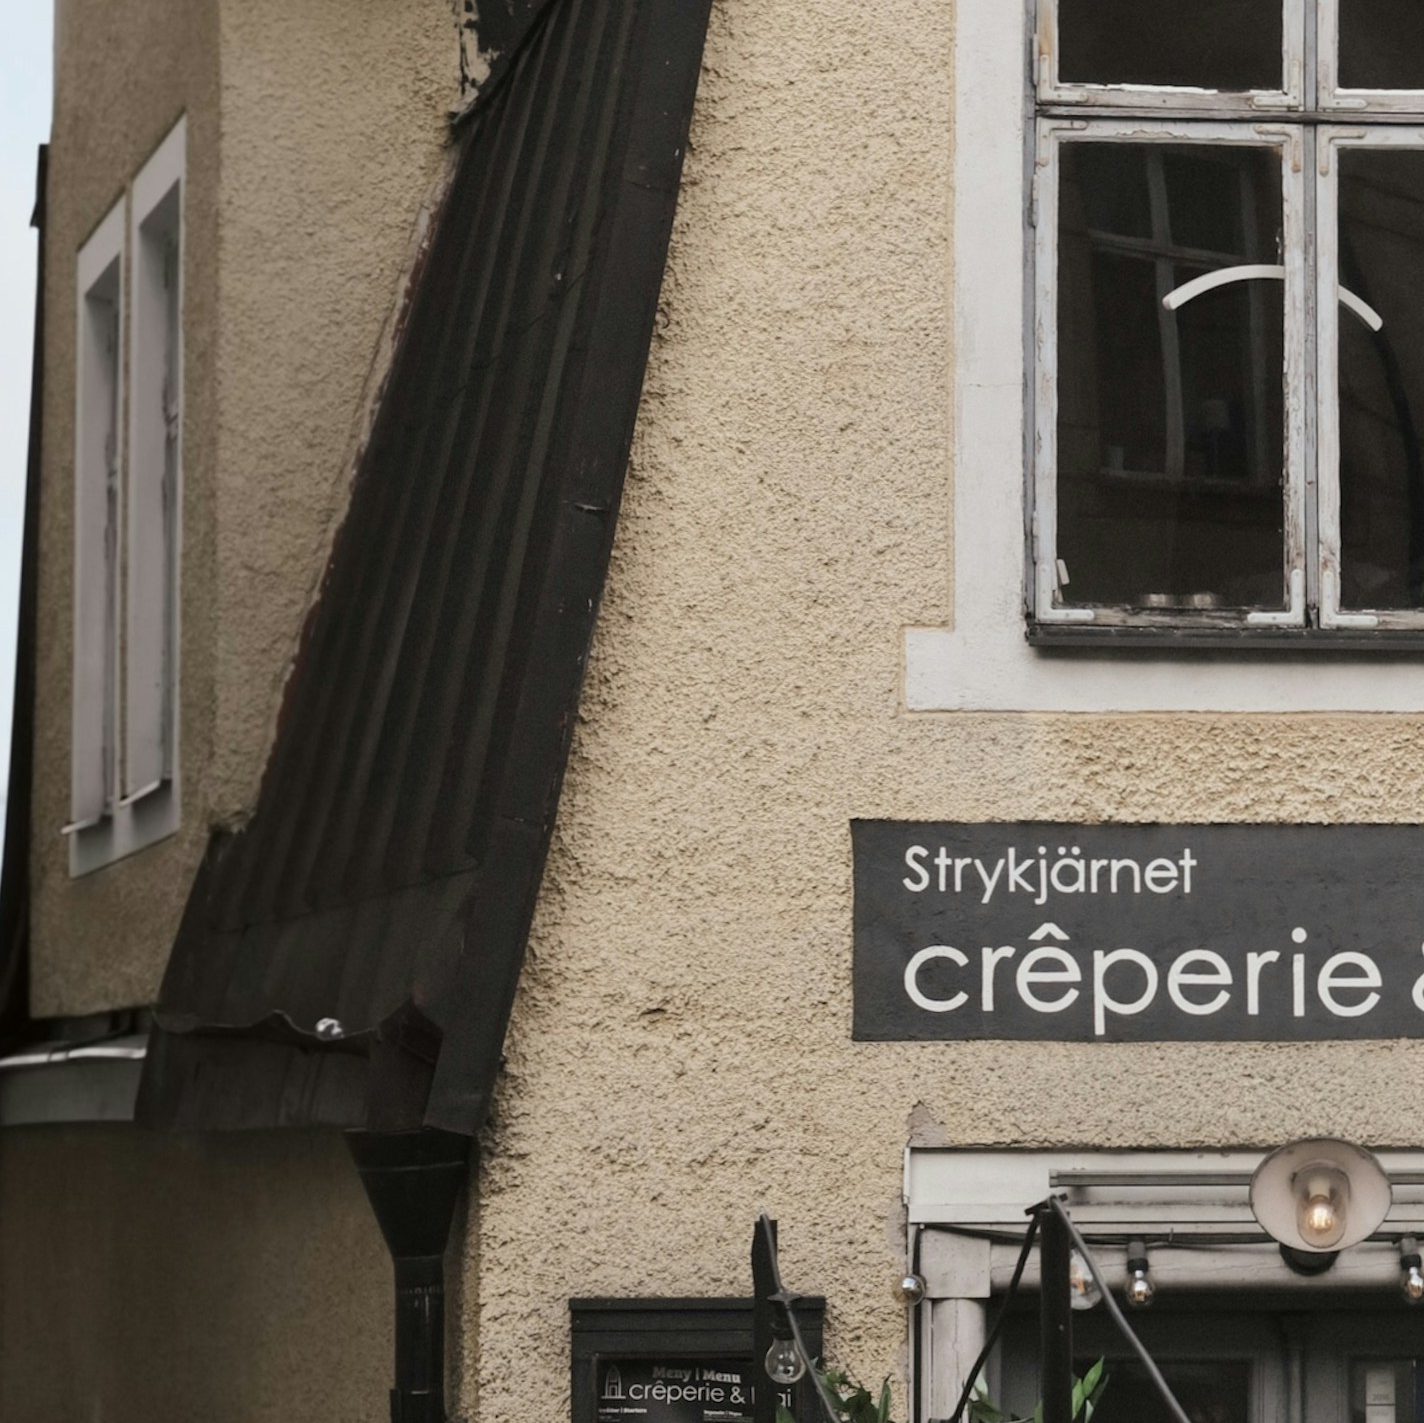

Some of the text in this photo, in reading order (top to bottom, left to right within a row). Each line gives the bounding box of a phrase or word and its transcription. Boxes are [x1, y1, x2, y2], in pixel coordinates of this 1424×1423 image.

[904, 845, 1198, 905] Strykjärnet
[903, 921, 1384, 1036] crêperie
[628, 1380, 725, 1405] crêperie
[729, 1386, 746, 1404] &
[652, 1366, 741, 1384] Meny Menu
